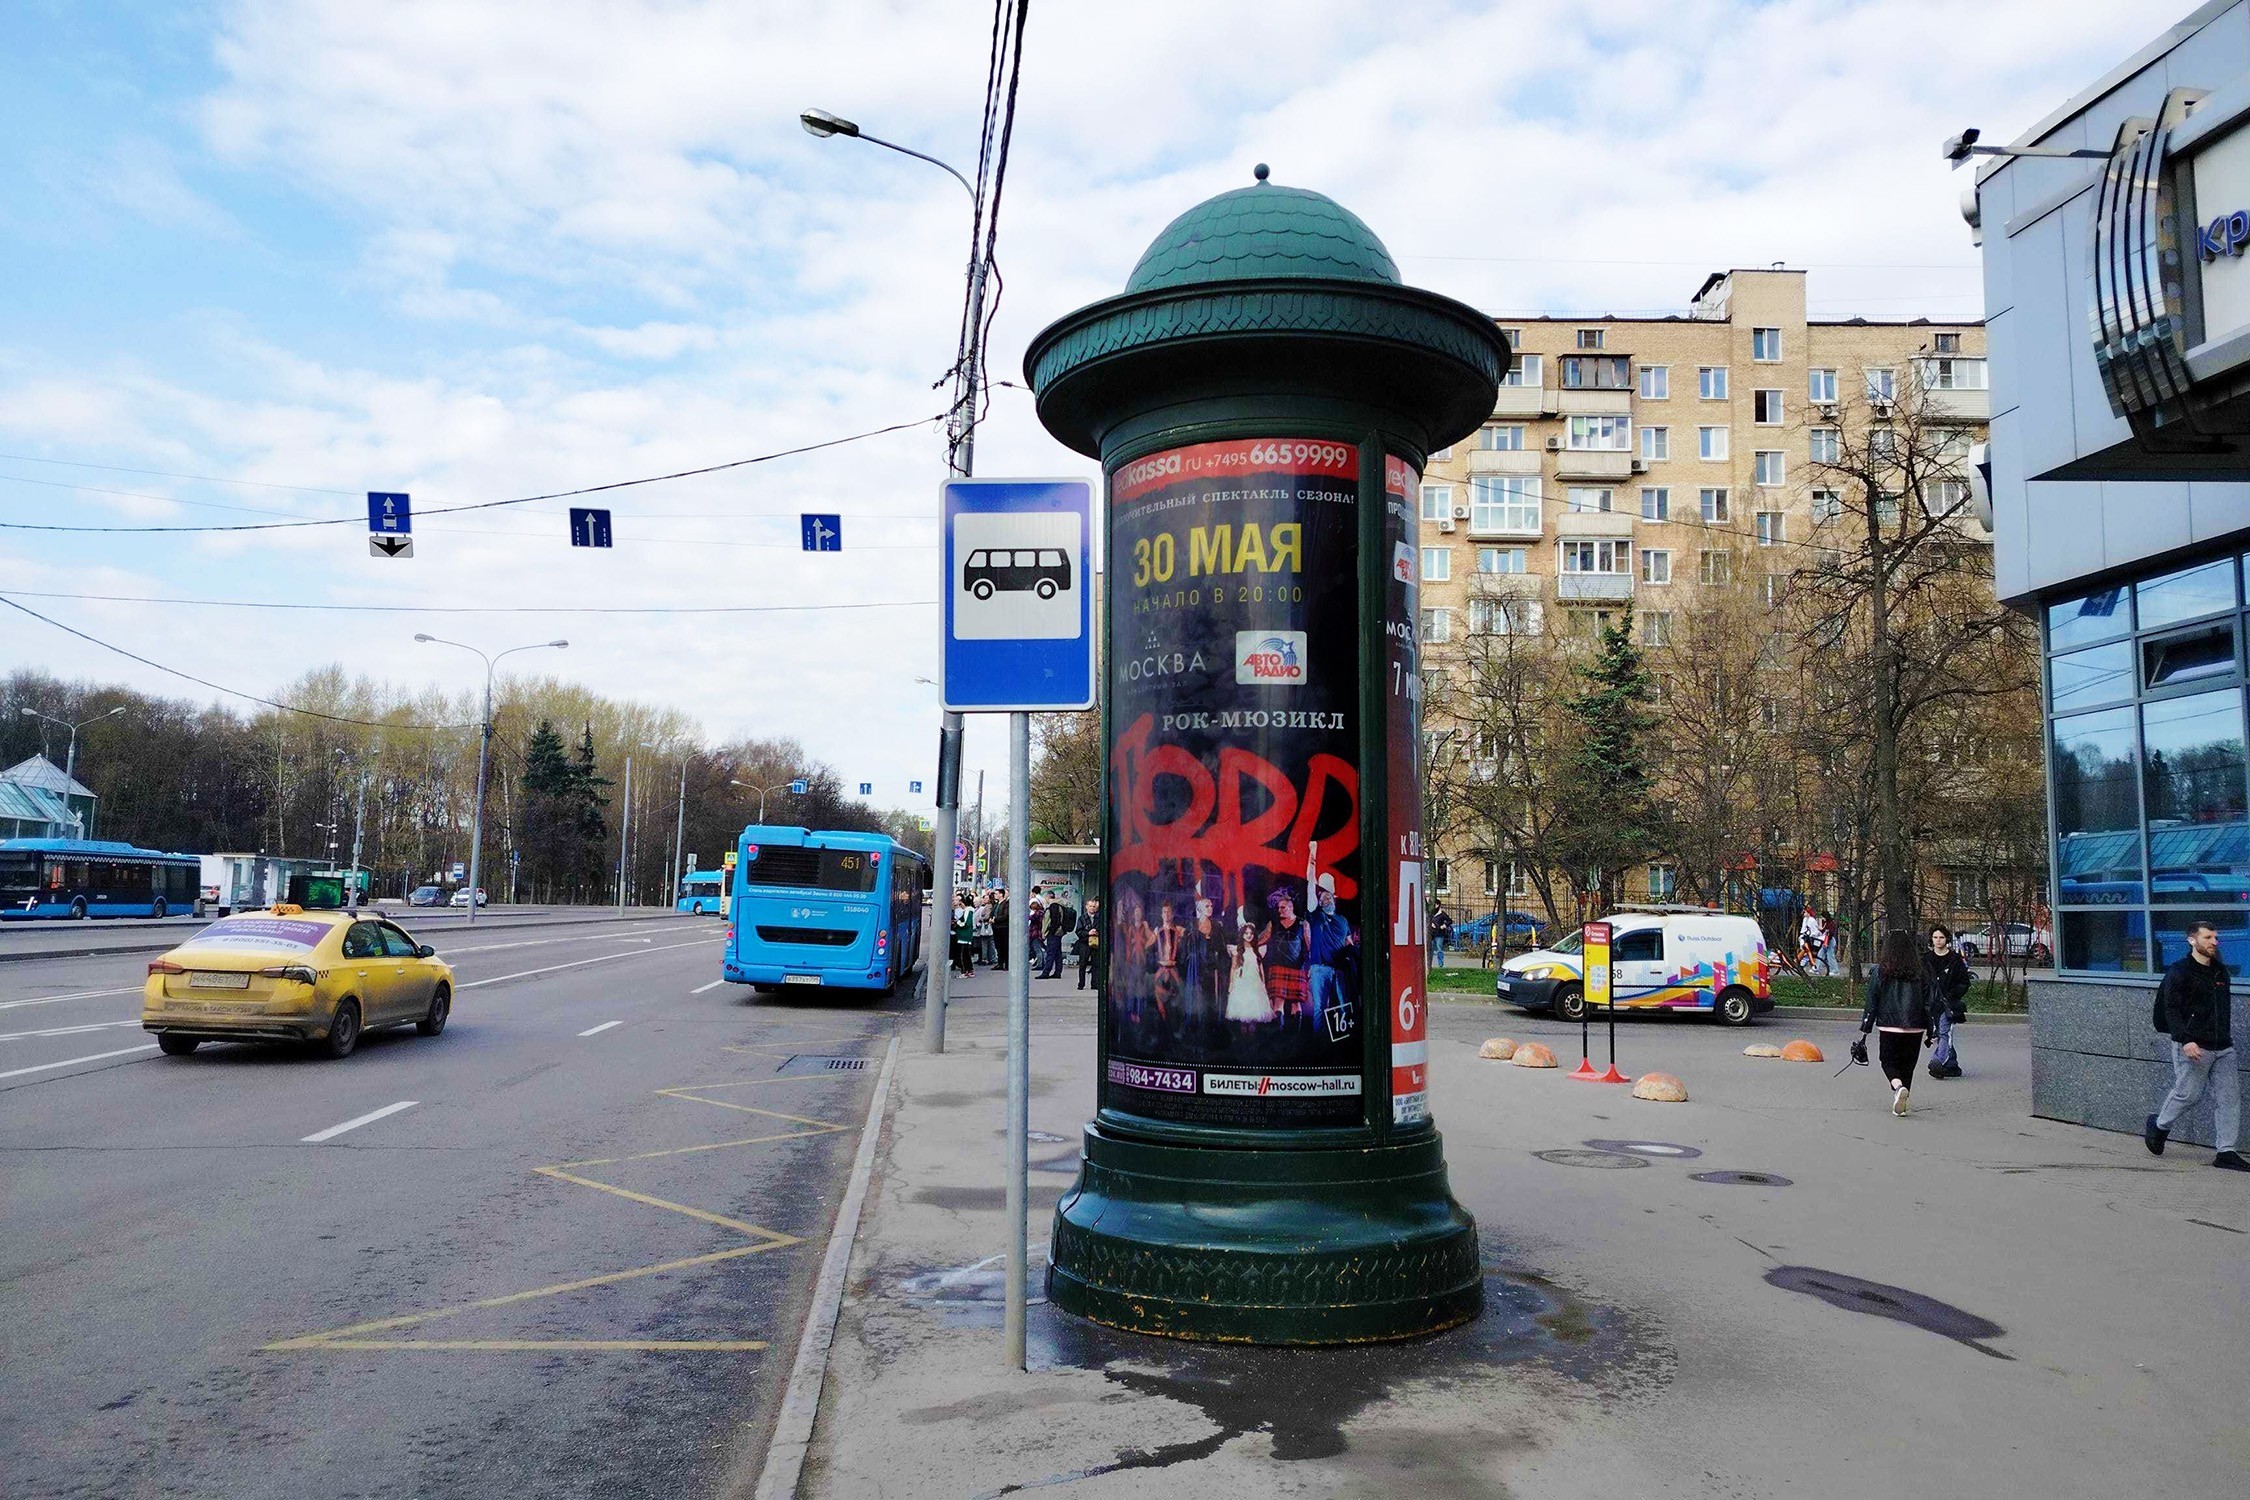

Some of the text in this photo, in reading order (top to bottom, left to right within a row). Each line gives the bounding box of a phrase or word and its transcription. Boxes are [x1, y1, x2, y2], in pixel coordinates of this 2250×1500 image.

[1202, 489, 1290, 503] СПЕКТАКЛЬ
[1297, 490, 1355, 504] СЕЗОНА!
[1133, 523, 1302, 588] 30 МАЯ
[1133, 586, 1302, 616] НАЧАЛО В 20:00
[1119, 650, 1207, 684] МОСКВА
[1242, 653, 1281, 666] АВТО
[1254, 665, 1301, 678] РАДИО
[1393, 661, 1401, 695] 7
[1162, 709, 1345, 732] РОК-МЮЗИКЛ
[841, 856, 860, 870] 451
[1398, 986, 1421, 1031] 6+
[1333, 1012, 1355, 1032] 16+
[1129, 1068, 1193, 1090] 984-7434
